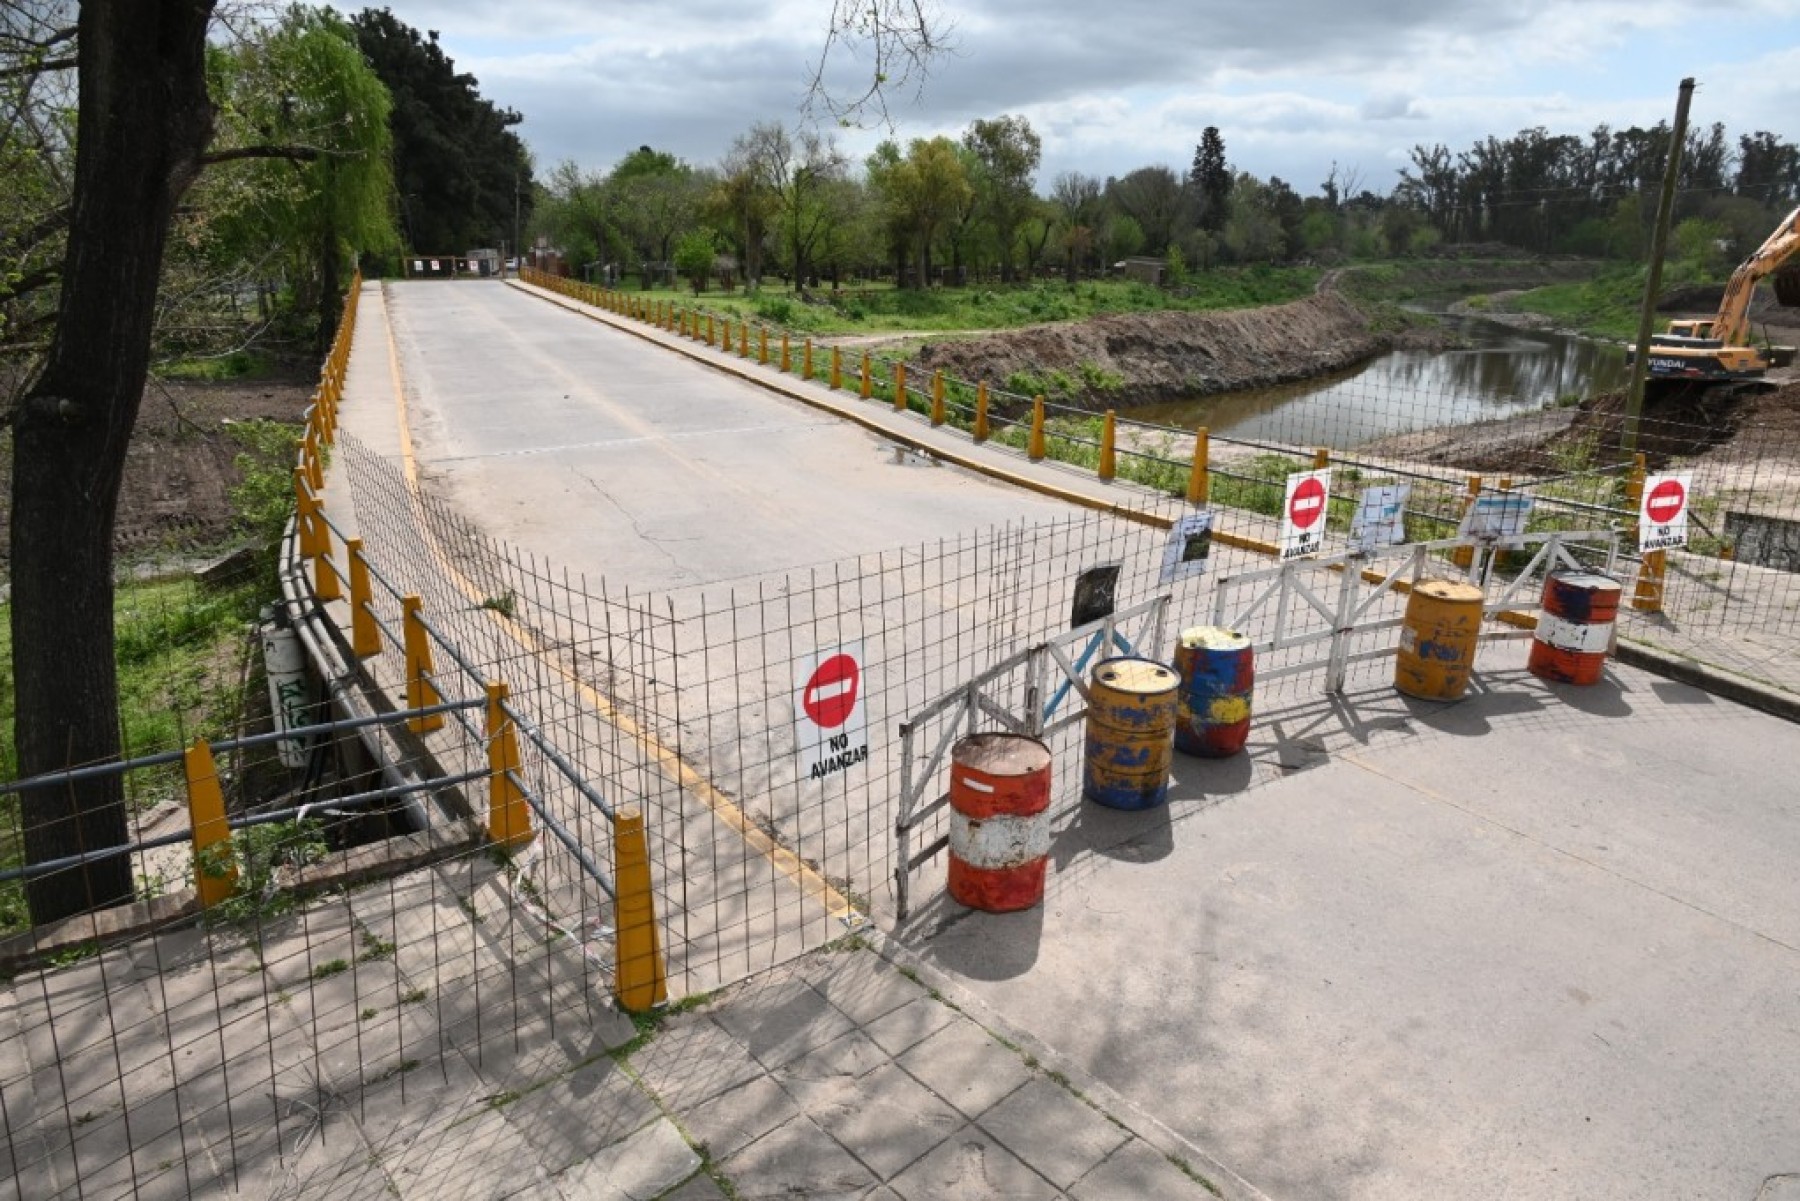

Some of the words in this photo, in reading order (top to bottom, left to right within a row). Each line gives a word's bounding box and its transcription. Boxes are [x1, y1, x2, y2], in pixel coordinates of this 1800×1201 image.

[1647, 358, 1686, 368] YUNDAI
[829, 733, 849, 753] NO
[811, 744, 868, 780] AVANZAR
